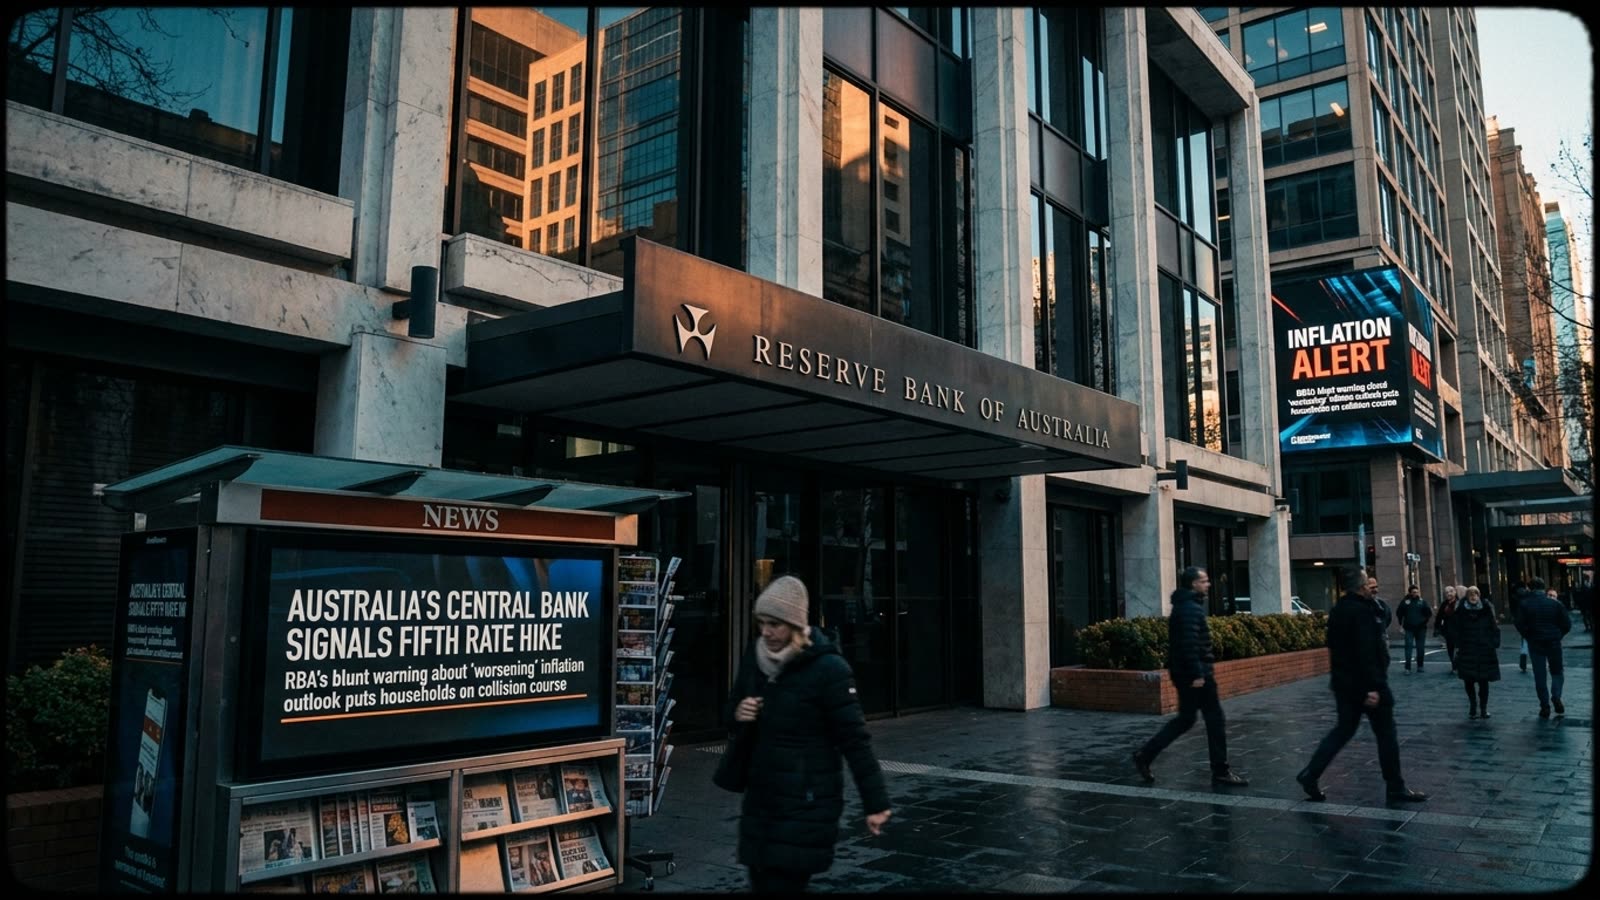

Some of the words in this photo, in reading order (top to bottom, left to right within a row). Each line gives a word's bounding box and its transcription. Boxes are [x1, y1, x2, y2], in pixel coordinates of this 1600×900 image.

[1288, 316, 1391, 349] INFLATION
[1292, 338, 1390, 380] ALERT
[752, 334, 886, 393] RESERVE
[905, 376, 966, 414] BANK
[980, 397, 1005, 423] OF
[1016, 407, 1111, 449] AUSTRALIA
[422, 504, 499, 532] NEWS
[287, 589, 441, 622] AUSTRALIA'S
[447, 590, 535, 620] CENTRAL
[541, 591, 590, 619] BANK
[286, 626, 393, 661] SIGNALS
[399, 625, 459, 657] FIFTH
[465, 624, 515, 654] RATE
[519, 623, 563, 652] HIKE
[285, 670, 329, 690] RBA's
[332, 668, 370, 687] blunt
[373, 666, 428, 688] warning
[431, 664, 468, 681] about
[470, 658, 539, 679] 'worsening'
[283, 691, 341, 712] outlook
[345, 690, 377, 712] puts
[380, 683, 456, 706] households
[459, 685, 475, 698] on
[478, 679, 527, 697] collision
[529, 678, 567, 693] course
